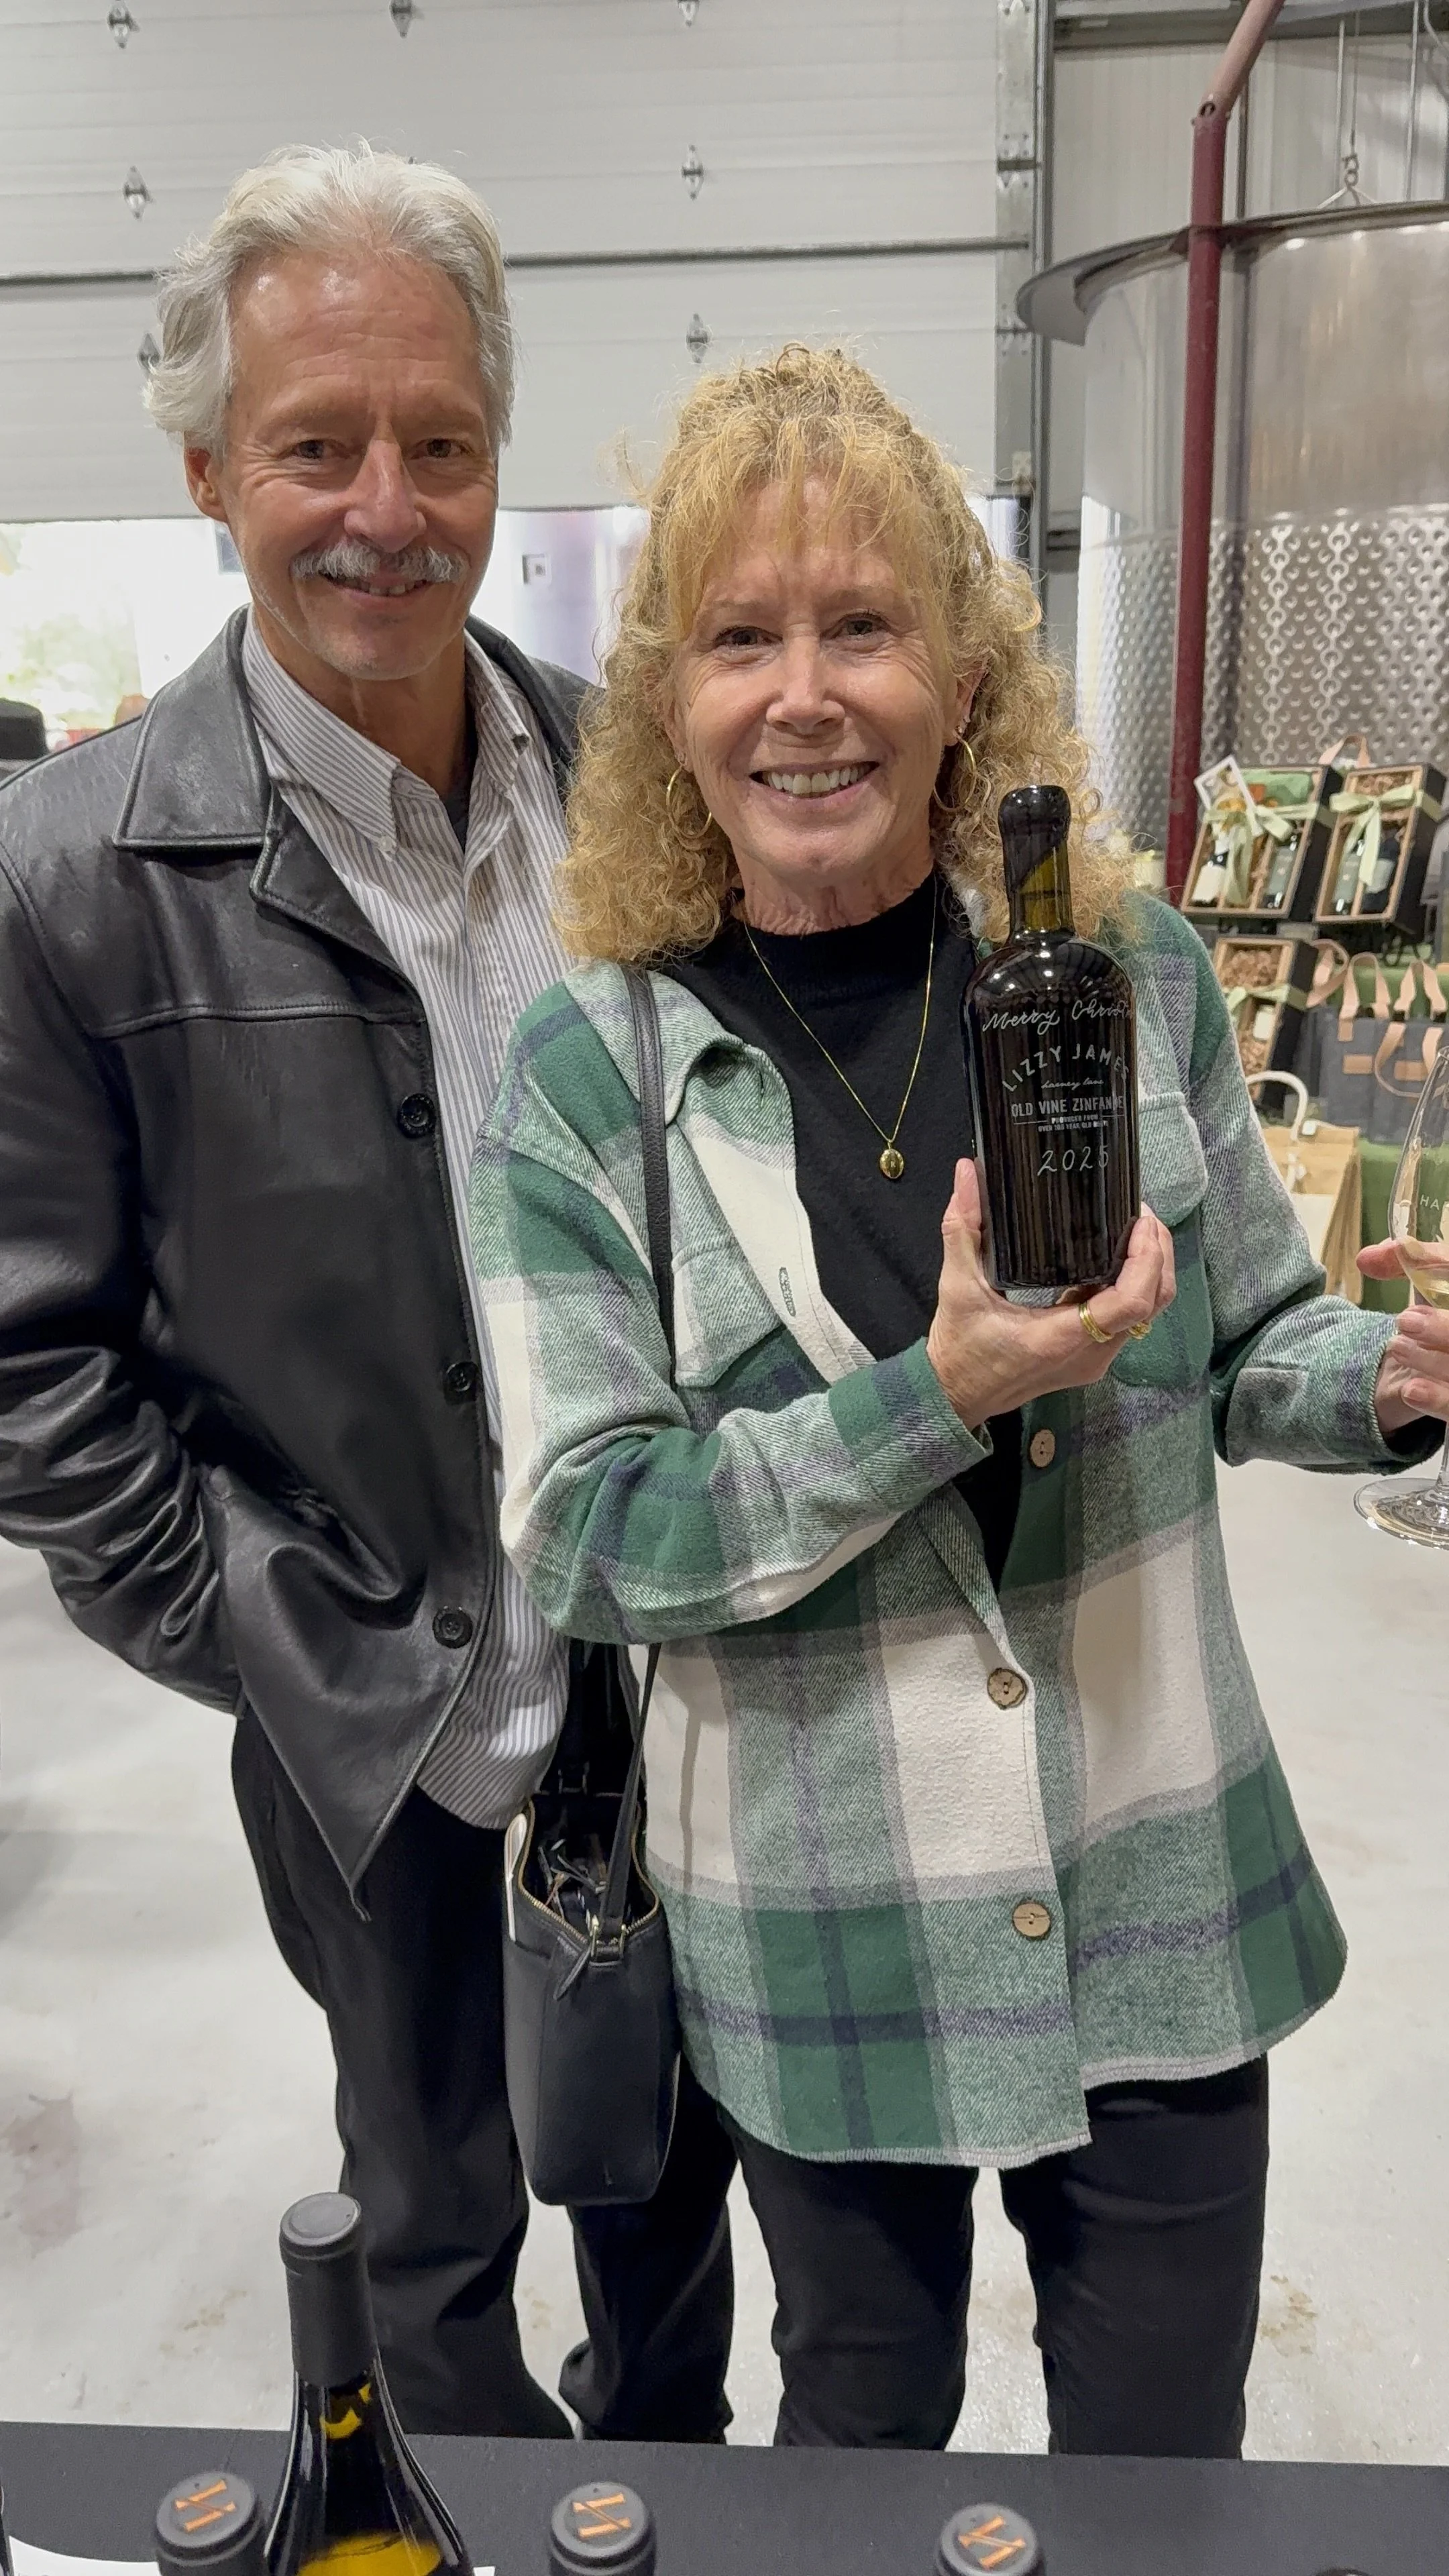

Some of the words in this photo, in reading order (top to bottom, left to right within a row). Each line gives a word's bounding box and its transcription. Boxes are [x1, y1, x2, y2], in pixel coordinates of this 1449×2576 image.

[983, 1010, 1060, 1034] Merry
[1002, 1045, 1062, 1091] LIZZY
[1011, 1103, 1033, 1117] OLD
[1038, 1099, 1068, 1114] VINE
[1037, 1145, 1109, 1176] 2025
